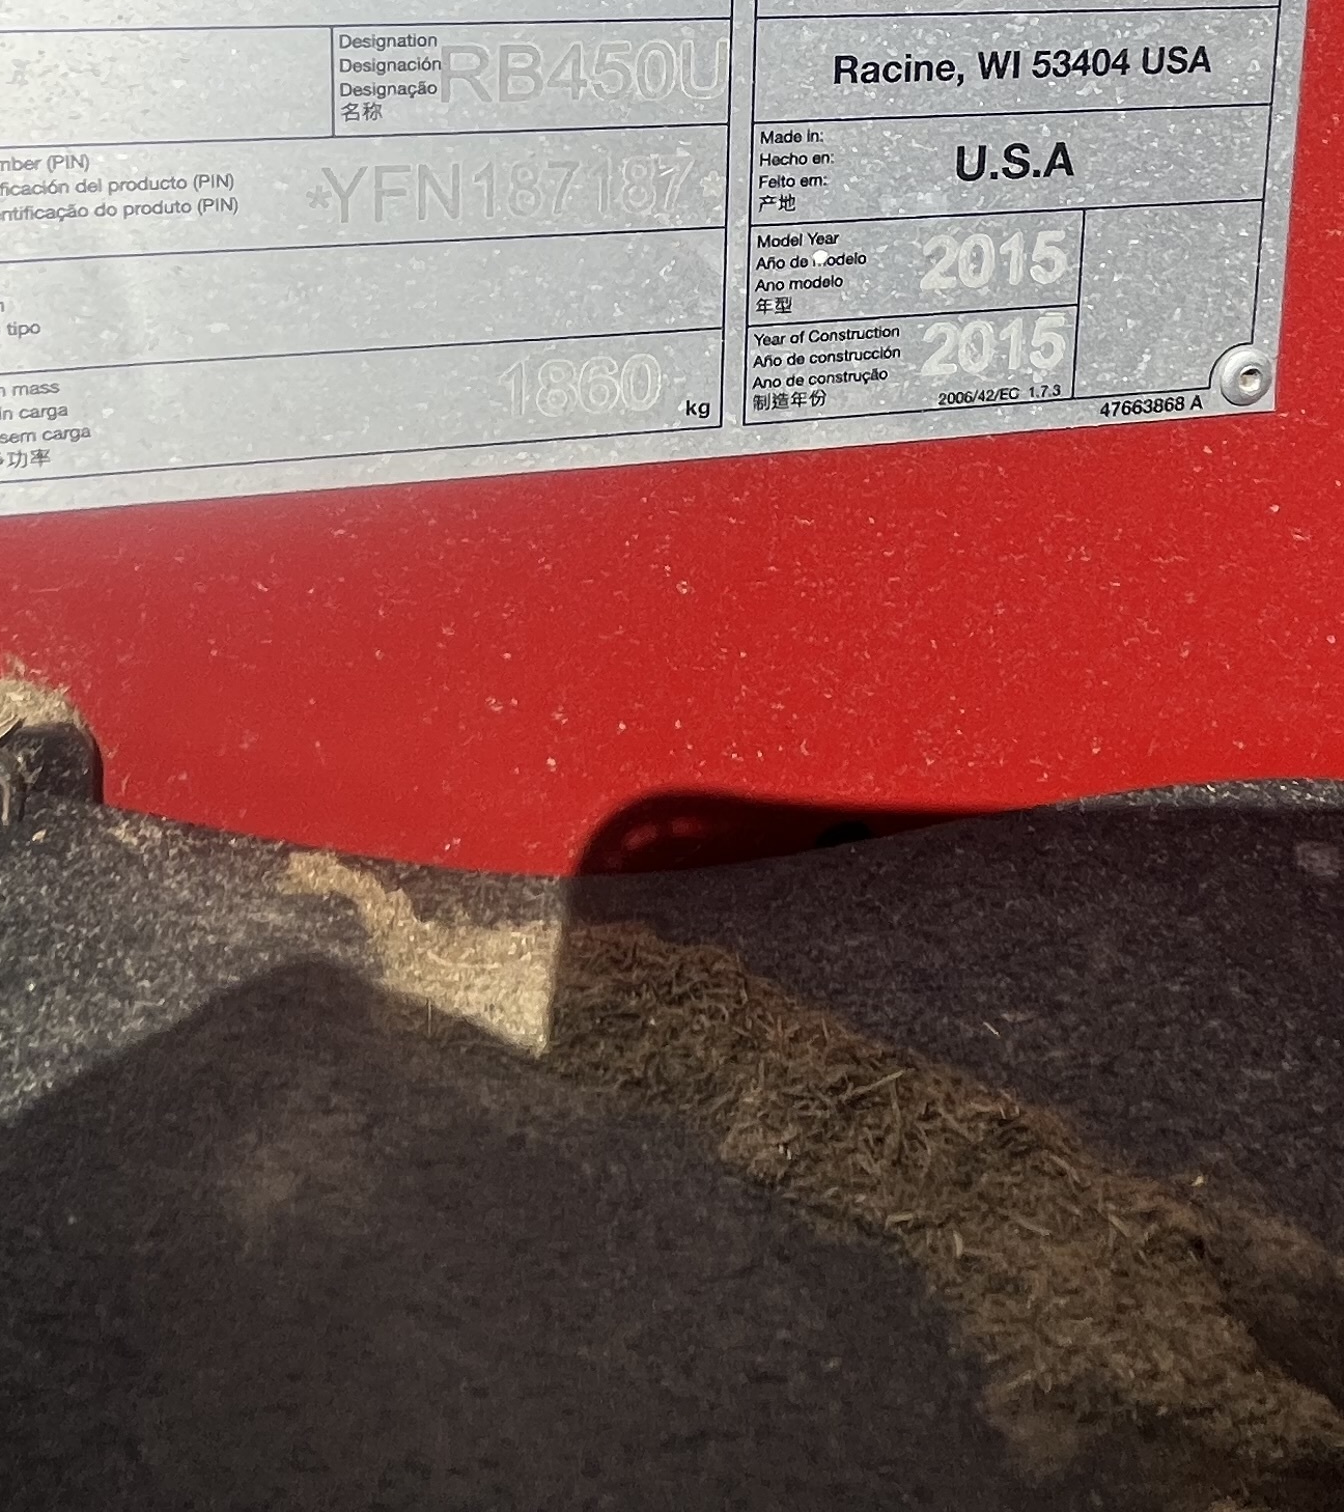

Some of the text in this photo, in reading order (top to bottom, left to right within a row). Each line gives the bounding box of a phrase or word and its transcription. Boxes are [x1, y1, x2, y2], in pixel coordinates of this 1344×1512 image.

[339, 34, 437, 52] Designation
[339, 57, 441, 75] Designación
[440, 38, 729, 104] RB450U
[834, 45, 1210, 86] Racine, WI 53404 USA
[340, 82, 437, 99] Designação
[341, 101, 383, 122] 名称
[760, 129, 824, 144] Made in:
[47, 154, 90, 172] (PIN)
[760, 151, 835, 166] Hecho en:
[956, 142, 1074, 181] U.S.A
[75, 177, 102, 194] del
[108, 175, 187, 196] producto
[194, 173, 234, 193] (PIN)
[759, 173, 828, 188] Feito em:
[94, 202, 117, 217] do
[123, 199, 191, 220] produto
[197, 197, 238, 216] (PIN)
[758, 195, 795, 213] 产地
[758, 232, 839, 248] Model Year
[756, 255, 786, 270] Año
[790, 255, 808, 268] de
[919, 230, 1067, 290] 2015
[755, 275, 843, 291] Ano modelo
[756, 297, 792, 315] 年型
[7, 321, 41, 339] tipo
[754, 326, 899, 346] Year of Construction
[920, 314, 1067, 376] 2015
[753, 346, 901, 368] Año de construcción
[499, 354, 710, 418] 1860 kg
[752, 368, 888, 389] Ano de construção
[12, 382, 60, 396] mass
[939, 384, 1061, 405] 2006/42/EC 1.7.3
[753, 390, 826, 410] 制造年份
[1100, 395, 1204, 417] 47663868 A
[20, 404, 68, 422] carga
[0, 430, 37, 443] sem
[42, 426, 91, 445] carga
